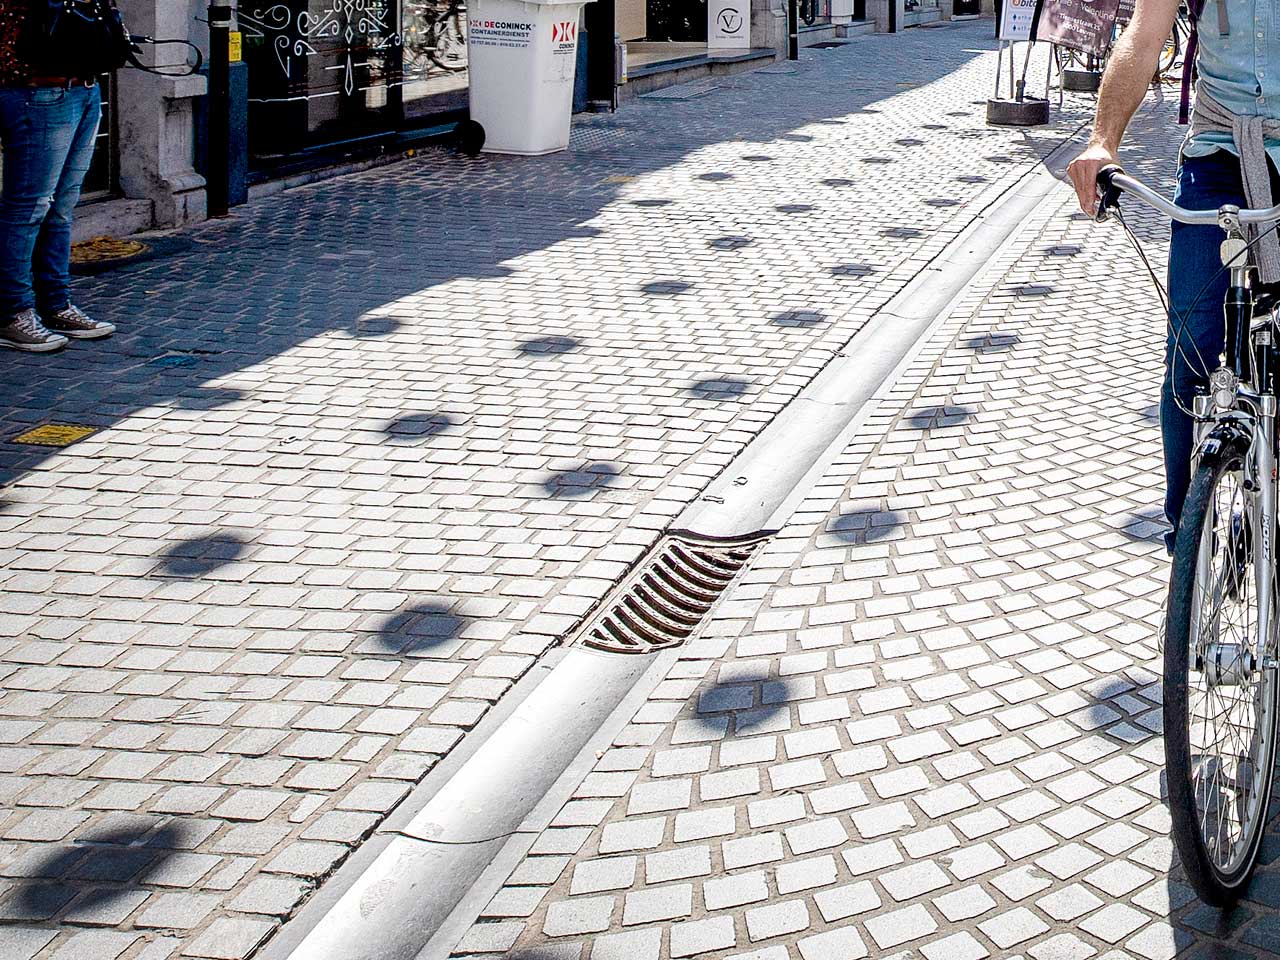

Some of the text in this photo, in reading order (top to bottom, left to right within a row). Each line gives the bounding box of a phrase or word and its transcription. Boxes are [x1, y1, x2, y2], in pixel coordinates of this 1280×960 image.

[484, 21, 532, 31] DECONINCK
[470, 28, 530, 38] CONTAINERDIENST
[1262, 513, 1271, 561] ZOOM
